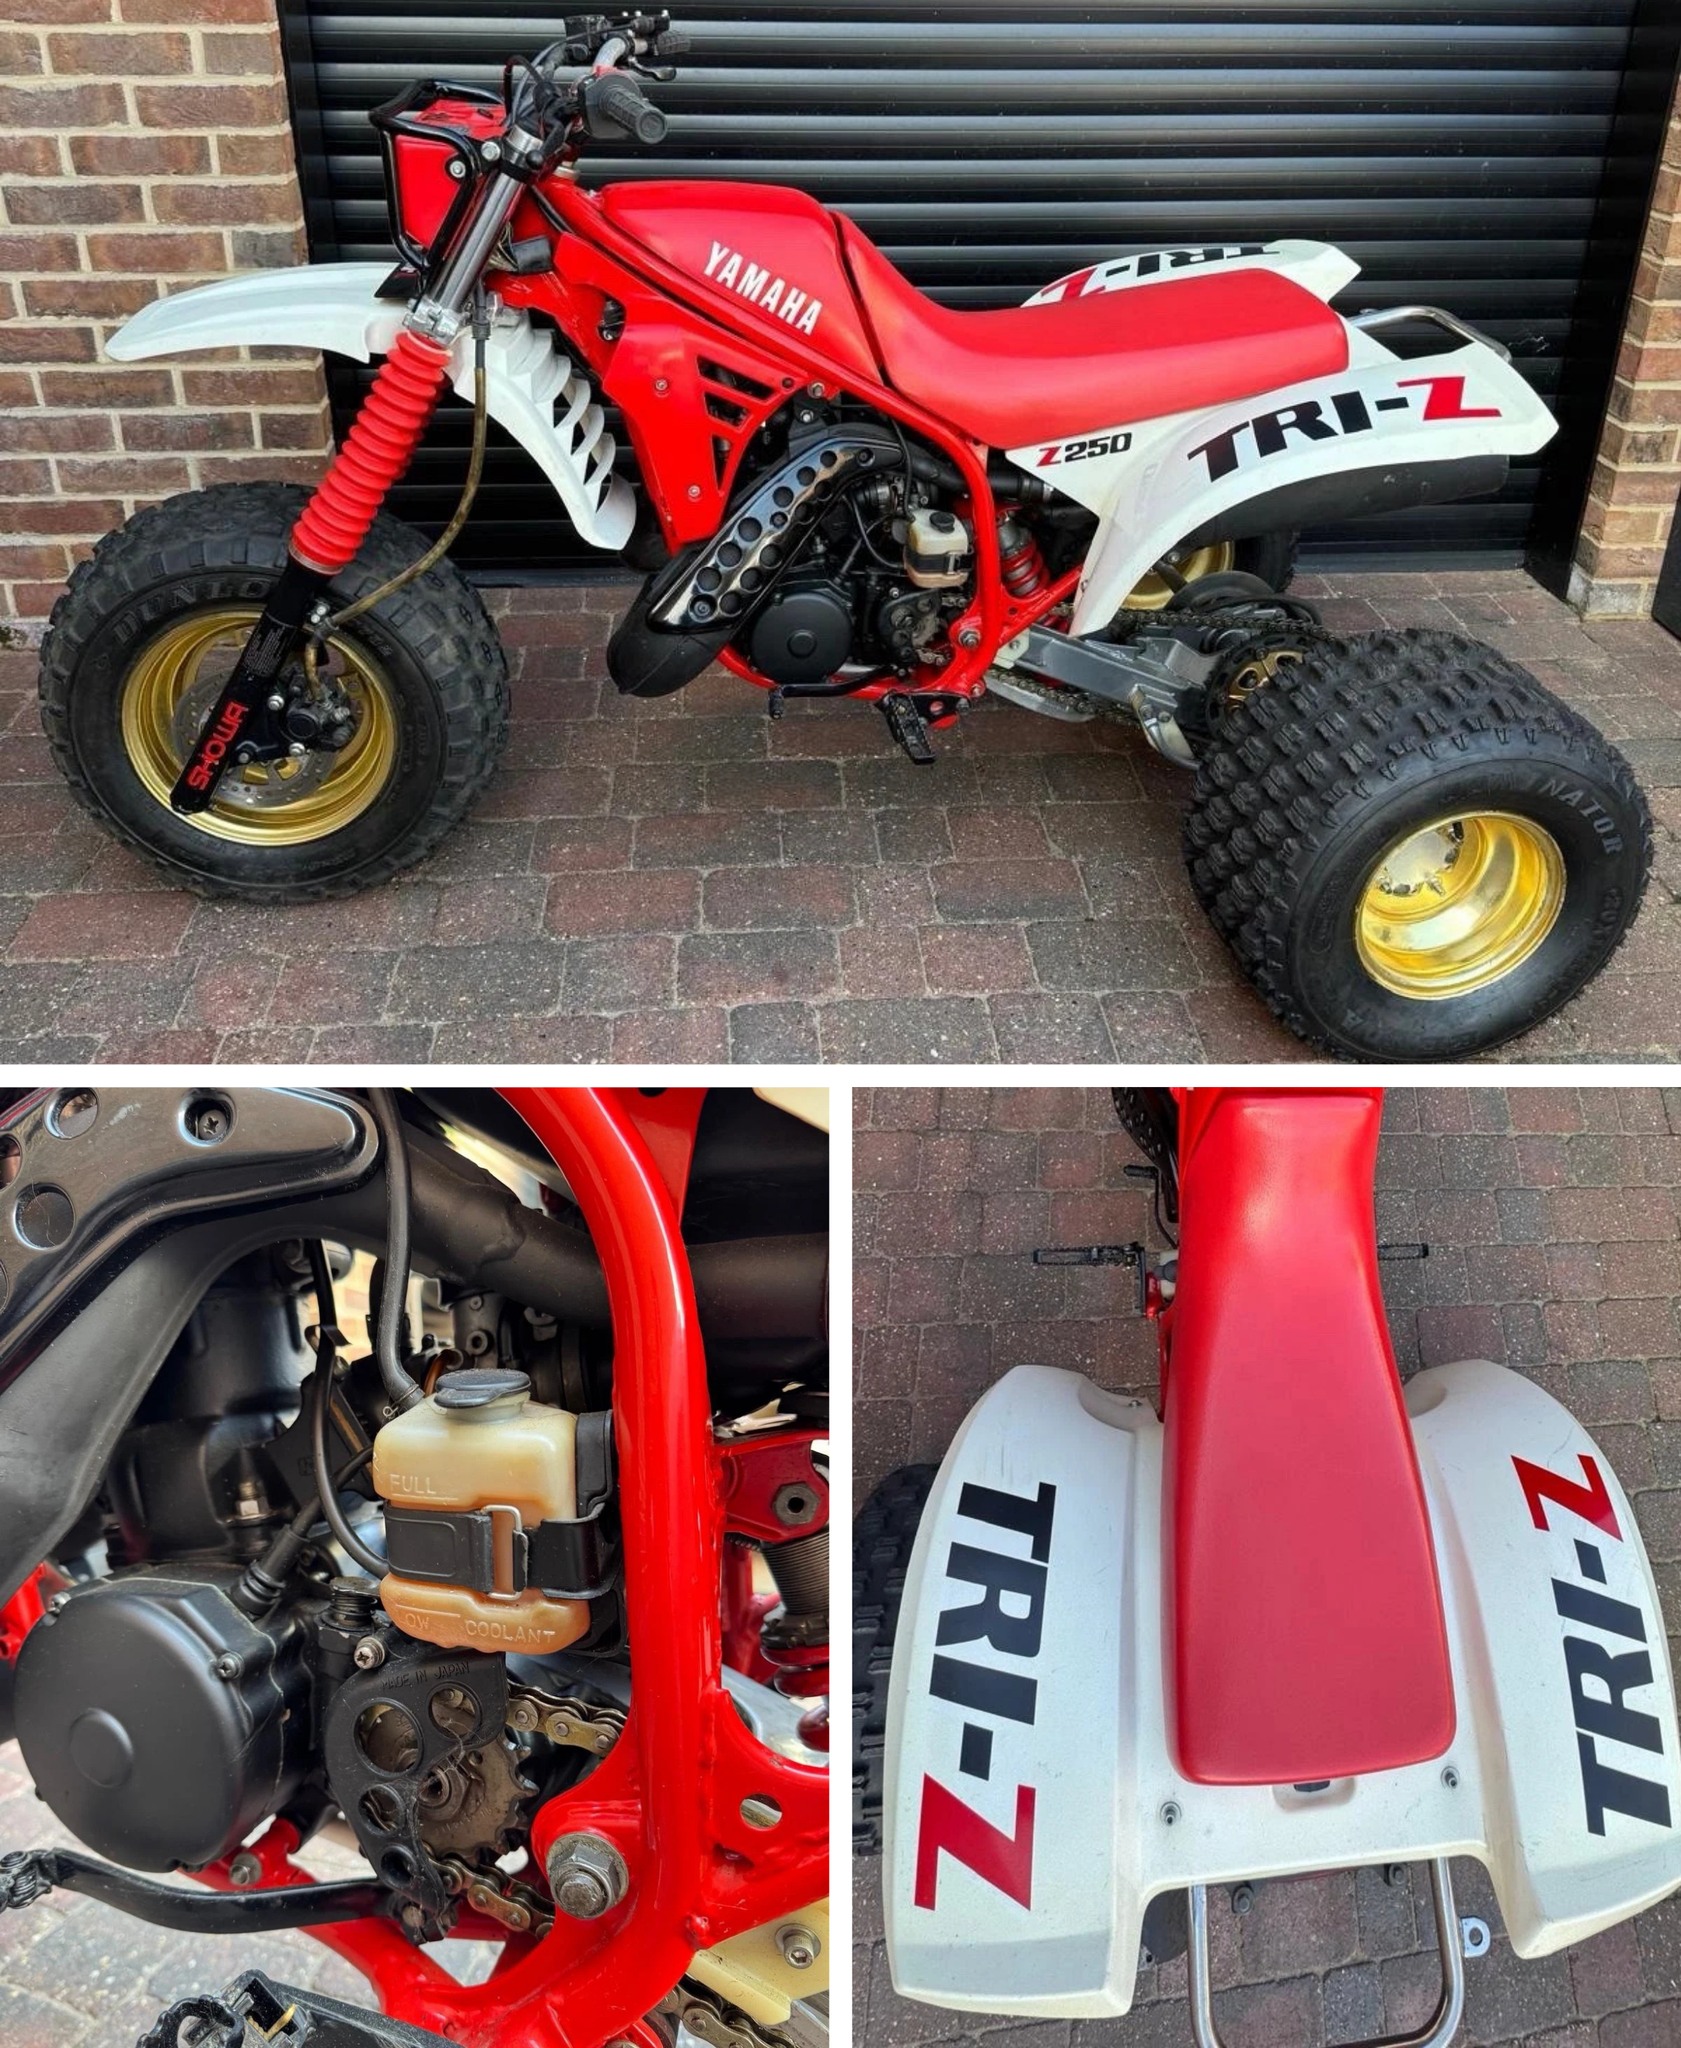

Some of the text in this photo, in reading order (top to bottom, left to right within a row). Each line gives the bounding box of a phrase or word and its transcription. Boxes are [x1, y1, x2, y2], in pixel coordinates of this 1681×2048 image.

[703, 240, 823, 336] YAMAHA
[1036, 431, 1133, 467] Z250
[1187, 375, 1503, 483] TRI-Z
[112, 575, 272, 646] DUNLO
[188, 701, 249, 791] SHOWA
[389, 1473, 437, 1495] FULL
[434, 1660, 471, 1680] JAPAN
[463, 1618, 556, 1646] COOLANT
[1510, 1452, 1672, 1837] TRI-Z
[914, 1481, 1057, 1912] TRI-Z
